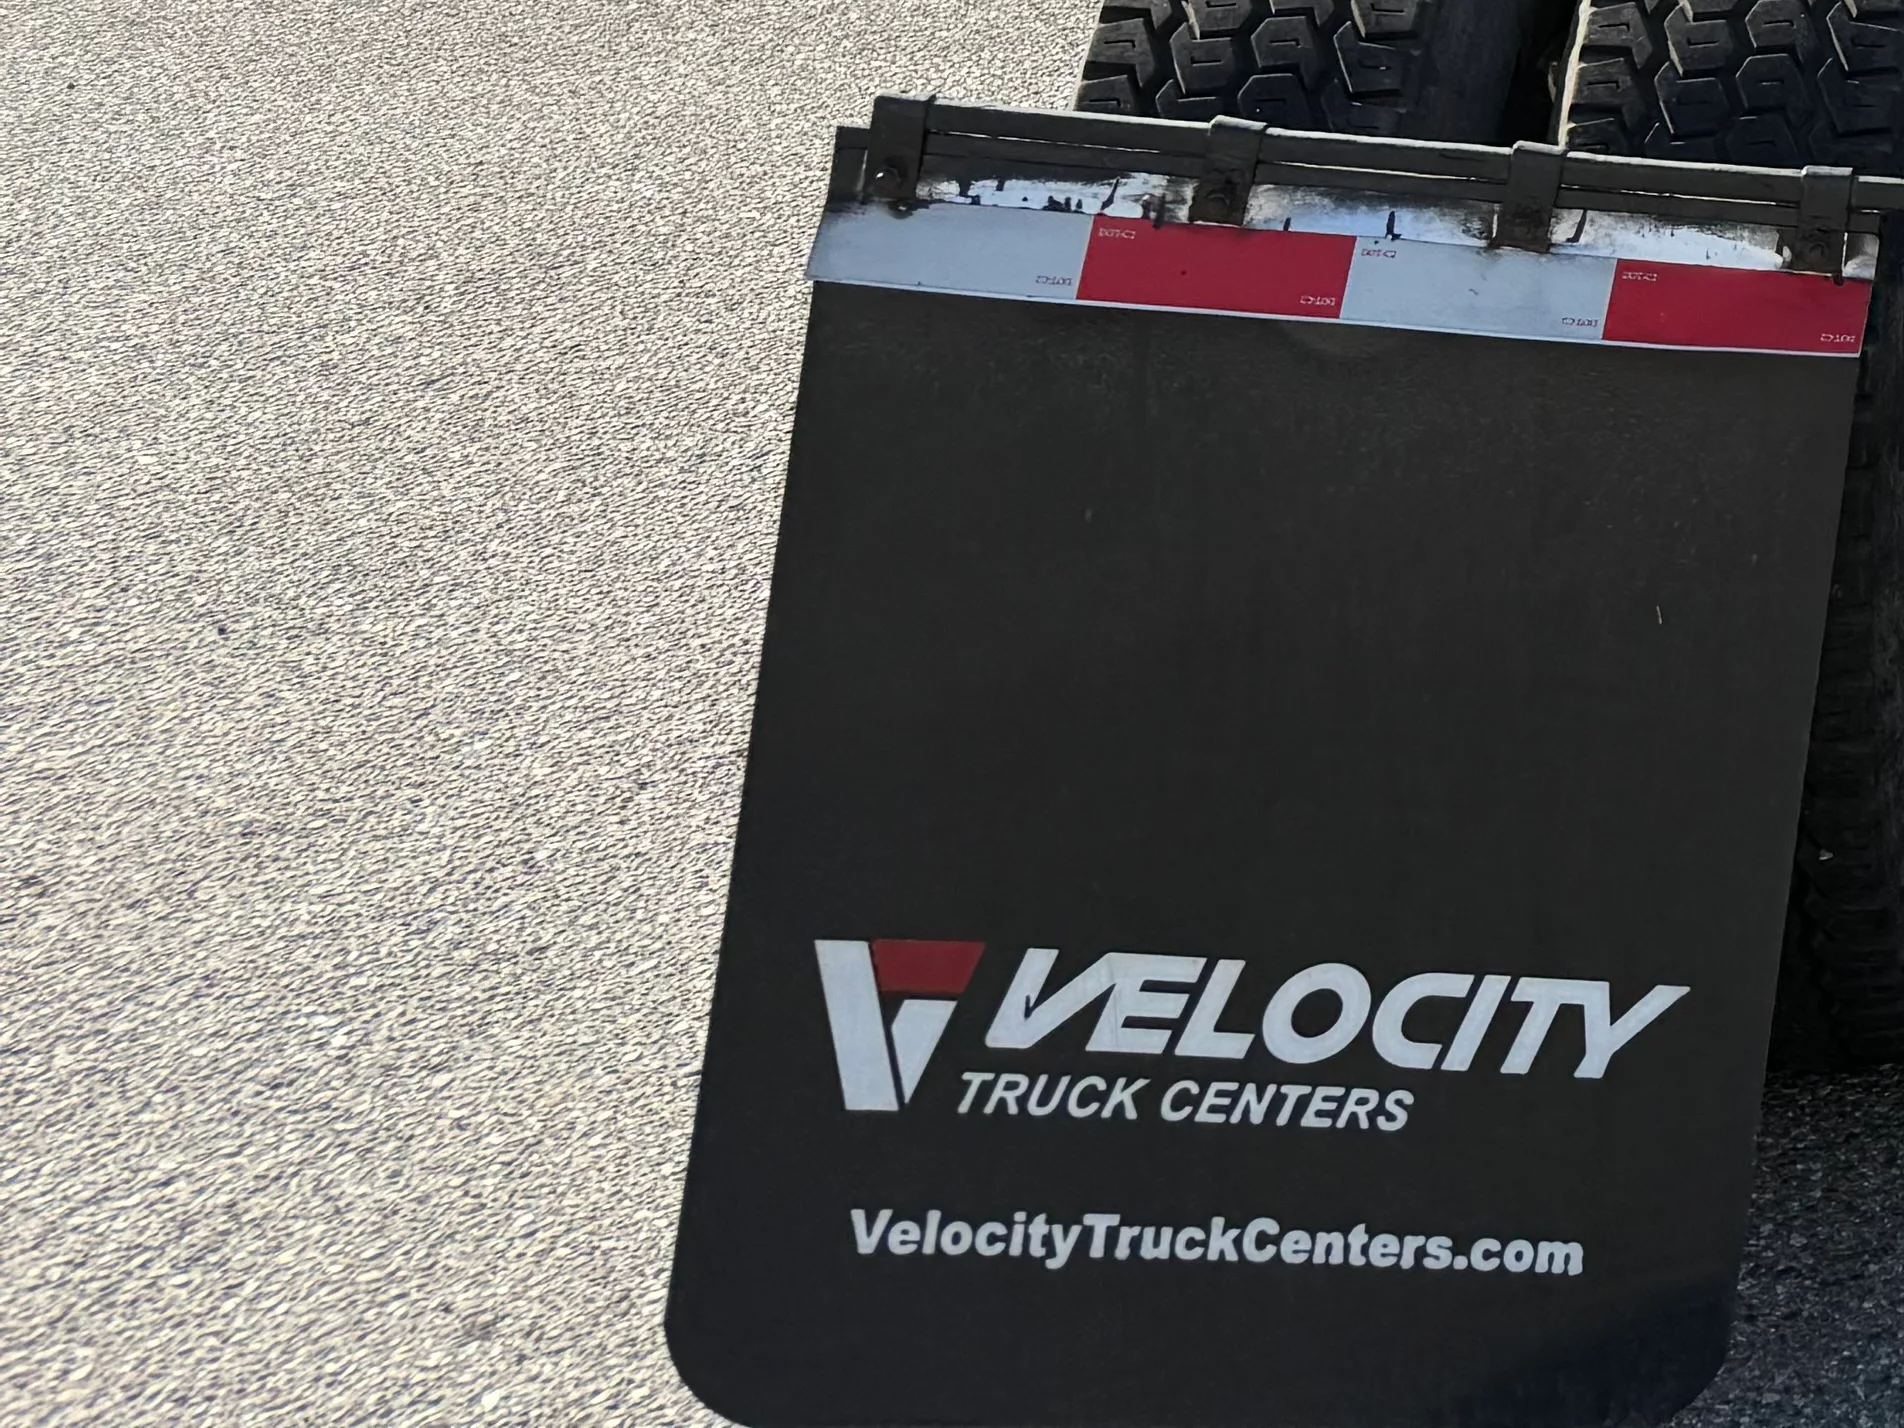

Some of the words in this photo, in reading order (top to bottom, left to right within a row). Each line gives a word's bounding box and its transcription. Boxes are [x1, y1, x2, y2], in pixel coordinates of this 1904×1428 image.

[986, 948, 1690, 1078] VELOCITY
[958, 1072, 1150, 1119] TRUCK
[1161, 1080, 1414, 1131] CENTERS
[851, 1209, 1583, 1275] VelocityTruckCenters.com
